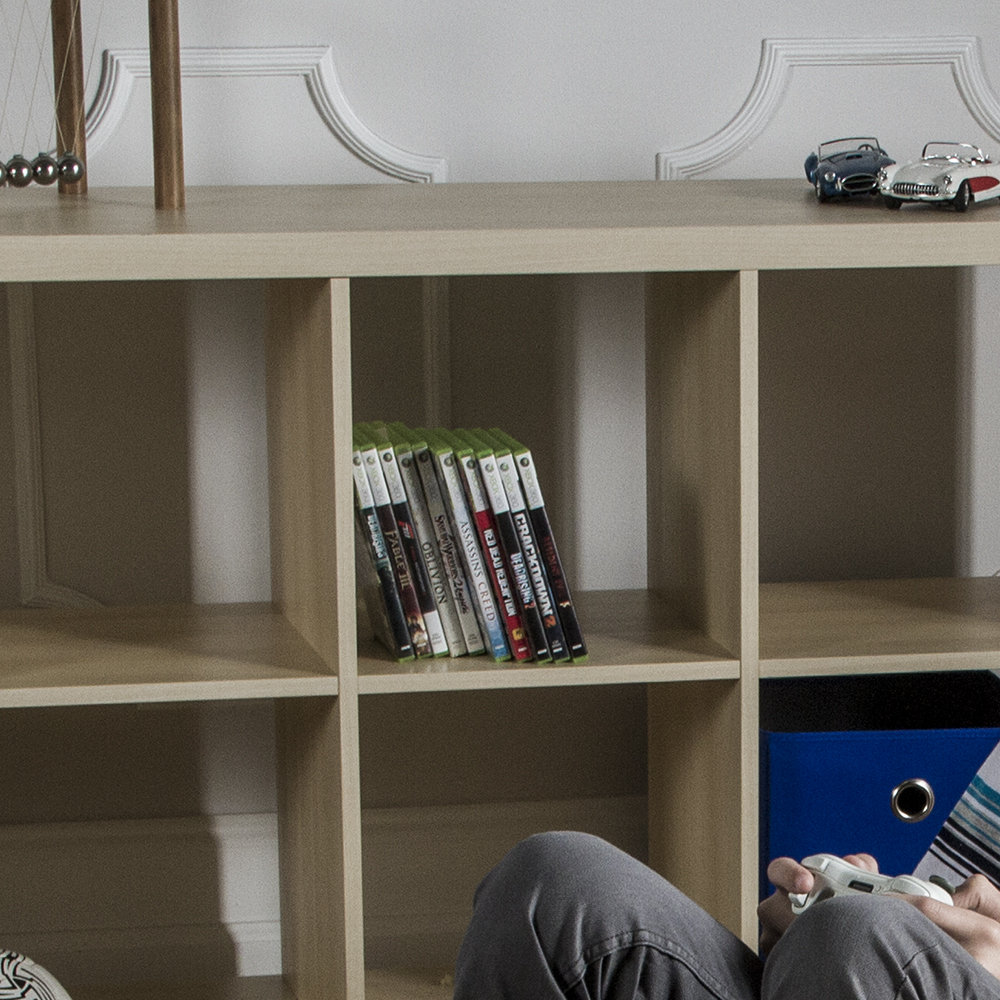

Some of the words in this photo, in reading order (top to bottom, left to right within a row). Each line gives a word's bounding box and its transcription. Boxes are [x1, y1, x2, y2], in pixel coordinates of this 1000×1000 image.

[386, 530, 405, 570] FABLE
[399, 573, 410, 588] III
[484, 529, 496, 546] RED
[489, 546, 503, 568] DEAD
[422, 543, 447, 605] OBLIVION
[452, 578, 463, 587] 2
[497, 568, 516, 616] REDEMPTION
[514, 513, 552, 616] CRACKDOWN
[544, 615, 556, 628] 2
[478, 582, 495, 622] CREED
